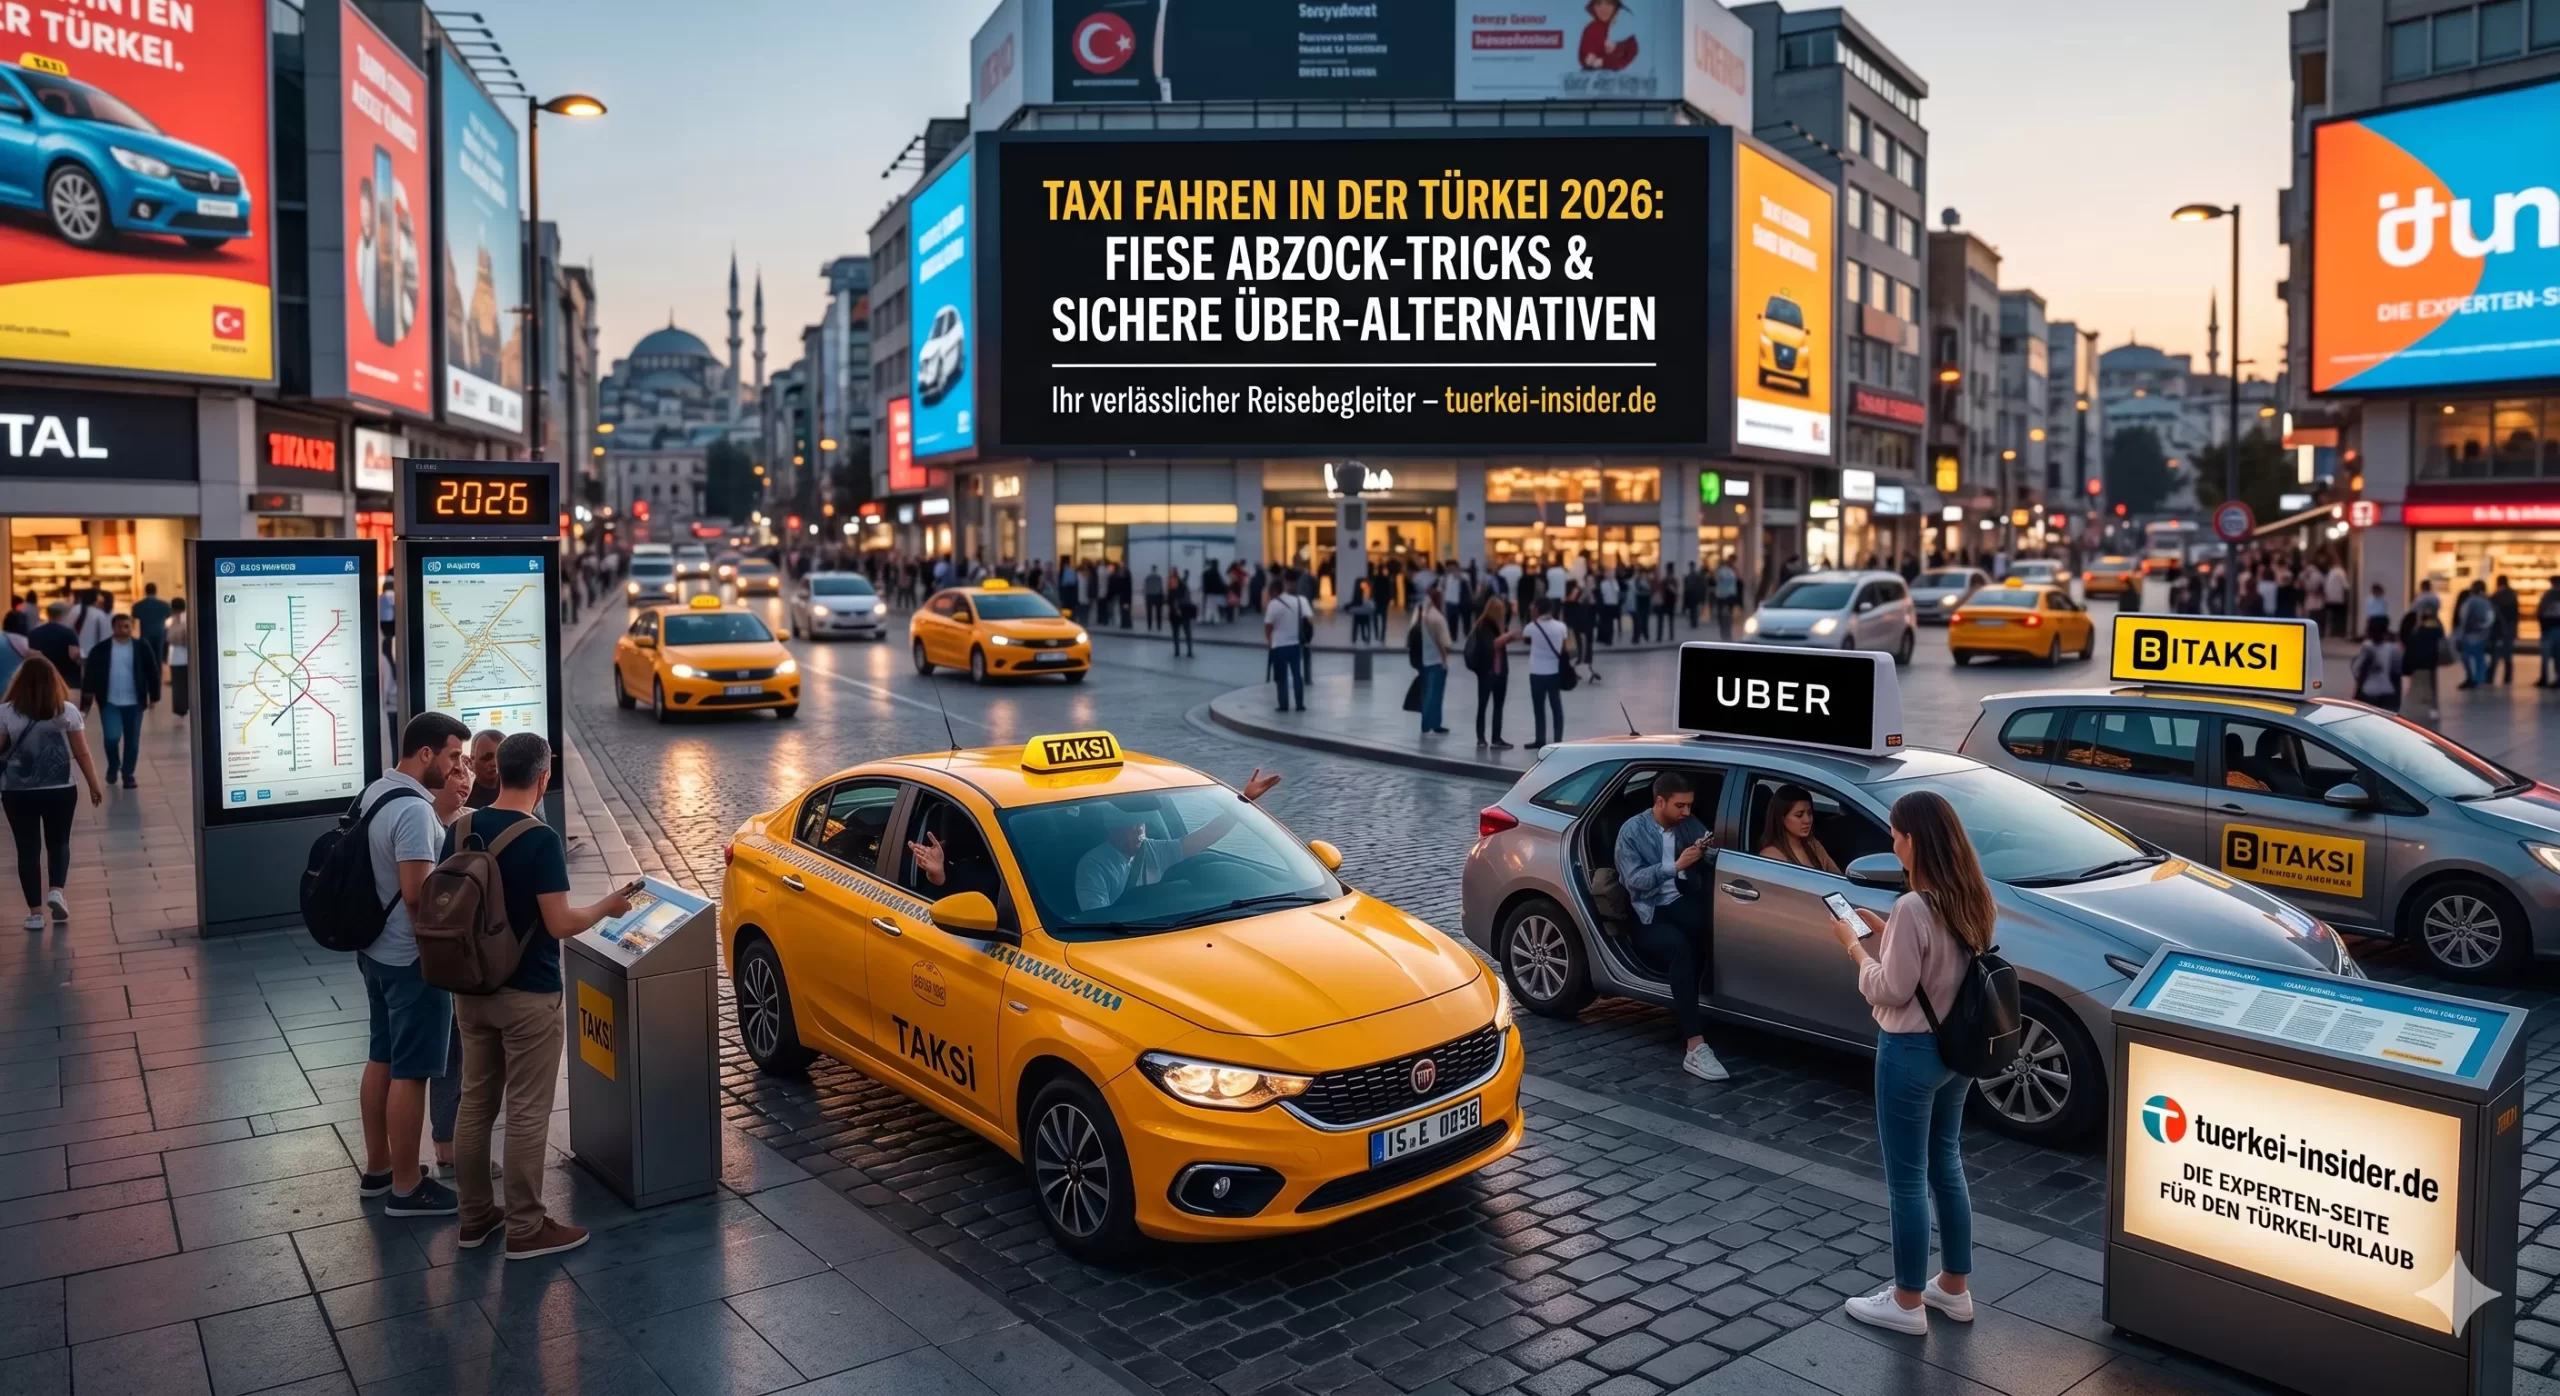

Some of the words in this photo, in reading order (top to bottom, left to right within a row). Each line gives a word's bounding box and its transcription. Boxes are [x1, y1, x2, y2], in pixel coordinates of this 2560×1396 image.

[0, 2, 32, 37] R
[40, 8, 185, 72] TÜRKEI.
[1043, 180, 1123, 221] TAXI
[1135, 180, 1276, 220] FAHREN
[1289, 180, 1325, 220] IN
[1338, 179, 1408, 220] DER
[1418, 169, 1548, 220] TÜRKEI
[1560, 178, 1664, 220] 2026:
[1106, 236, 1215, 281] FIESE
[1226, 235, 1552, 281] ABZOCK-TRICKS
[1564, 235, 1594, 280] &
[1052, 296, 1222, 342] SICHERE
[1235, 286, 1656, 342] ÜBER-ALTERNATIVEN
[2377, 302, 2412, 322] DIE
[2418, 286, 2560, 319] EXPERTEN-S
[1052, 386, 1084, 413] Ihr
[1091, 385, 1240, 413] verlässlicher
[1249, 385, 1416, 419] Reisebegleiter
[1445, 385, 1657, 413] tuerkei-insider.de
[437, 481, 528, 515] 2026
[2140, 637, 2277, 670] BITAKSI
[1716, 676, 1831, 716] UBER
[1046, 738, 1110, 762] TAKSI
[2233, 838, 2353, 875] BITAKSI
[2195, 1114, 2440, 1202] tuerkei-insider.de
[2183, 1162, 2213, 1187] DIE
[2219, 1173, 2390, 1236] EXPERTEN-SEITE
[2160, 1181, 2196, 1208] FÜR
[2202, 1195, 2240, 1221] DEN
[2247, 1204, 2415, 1270] TÜRKEI-URLAUB
